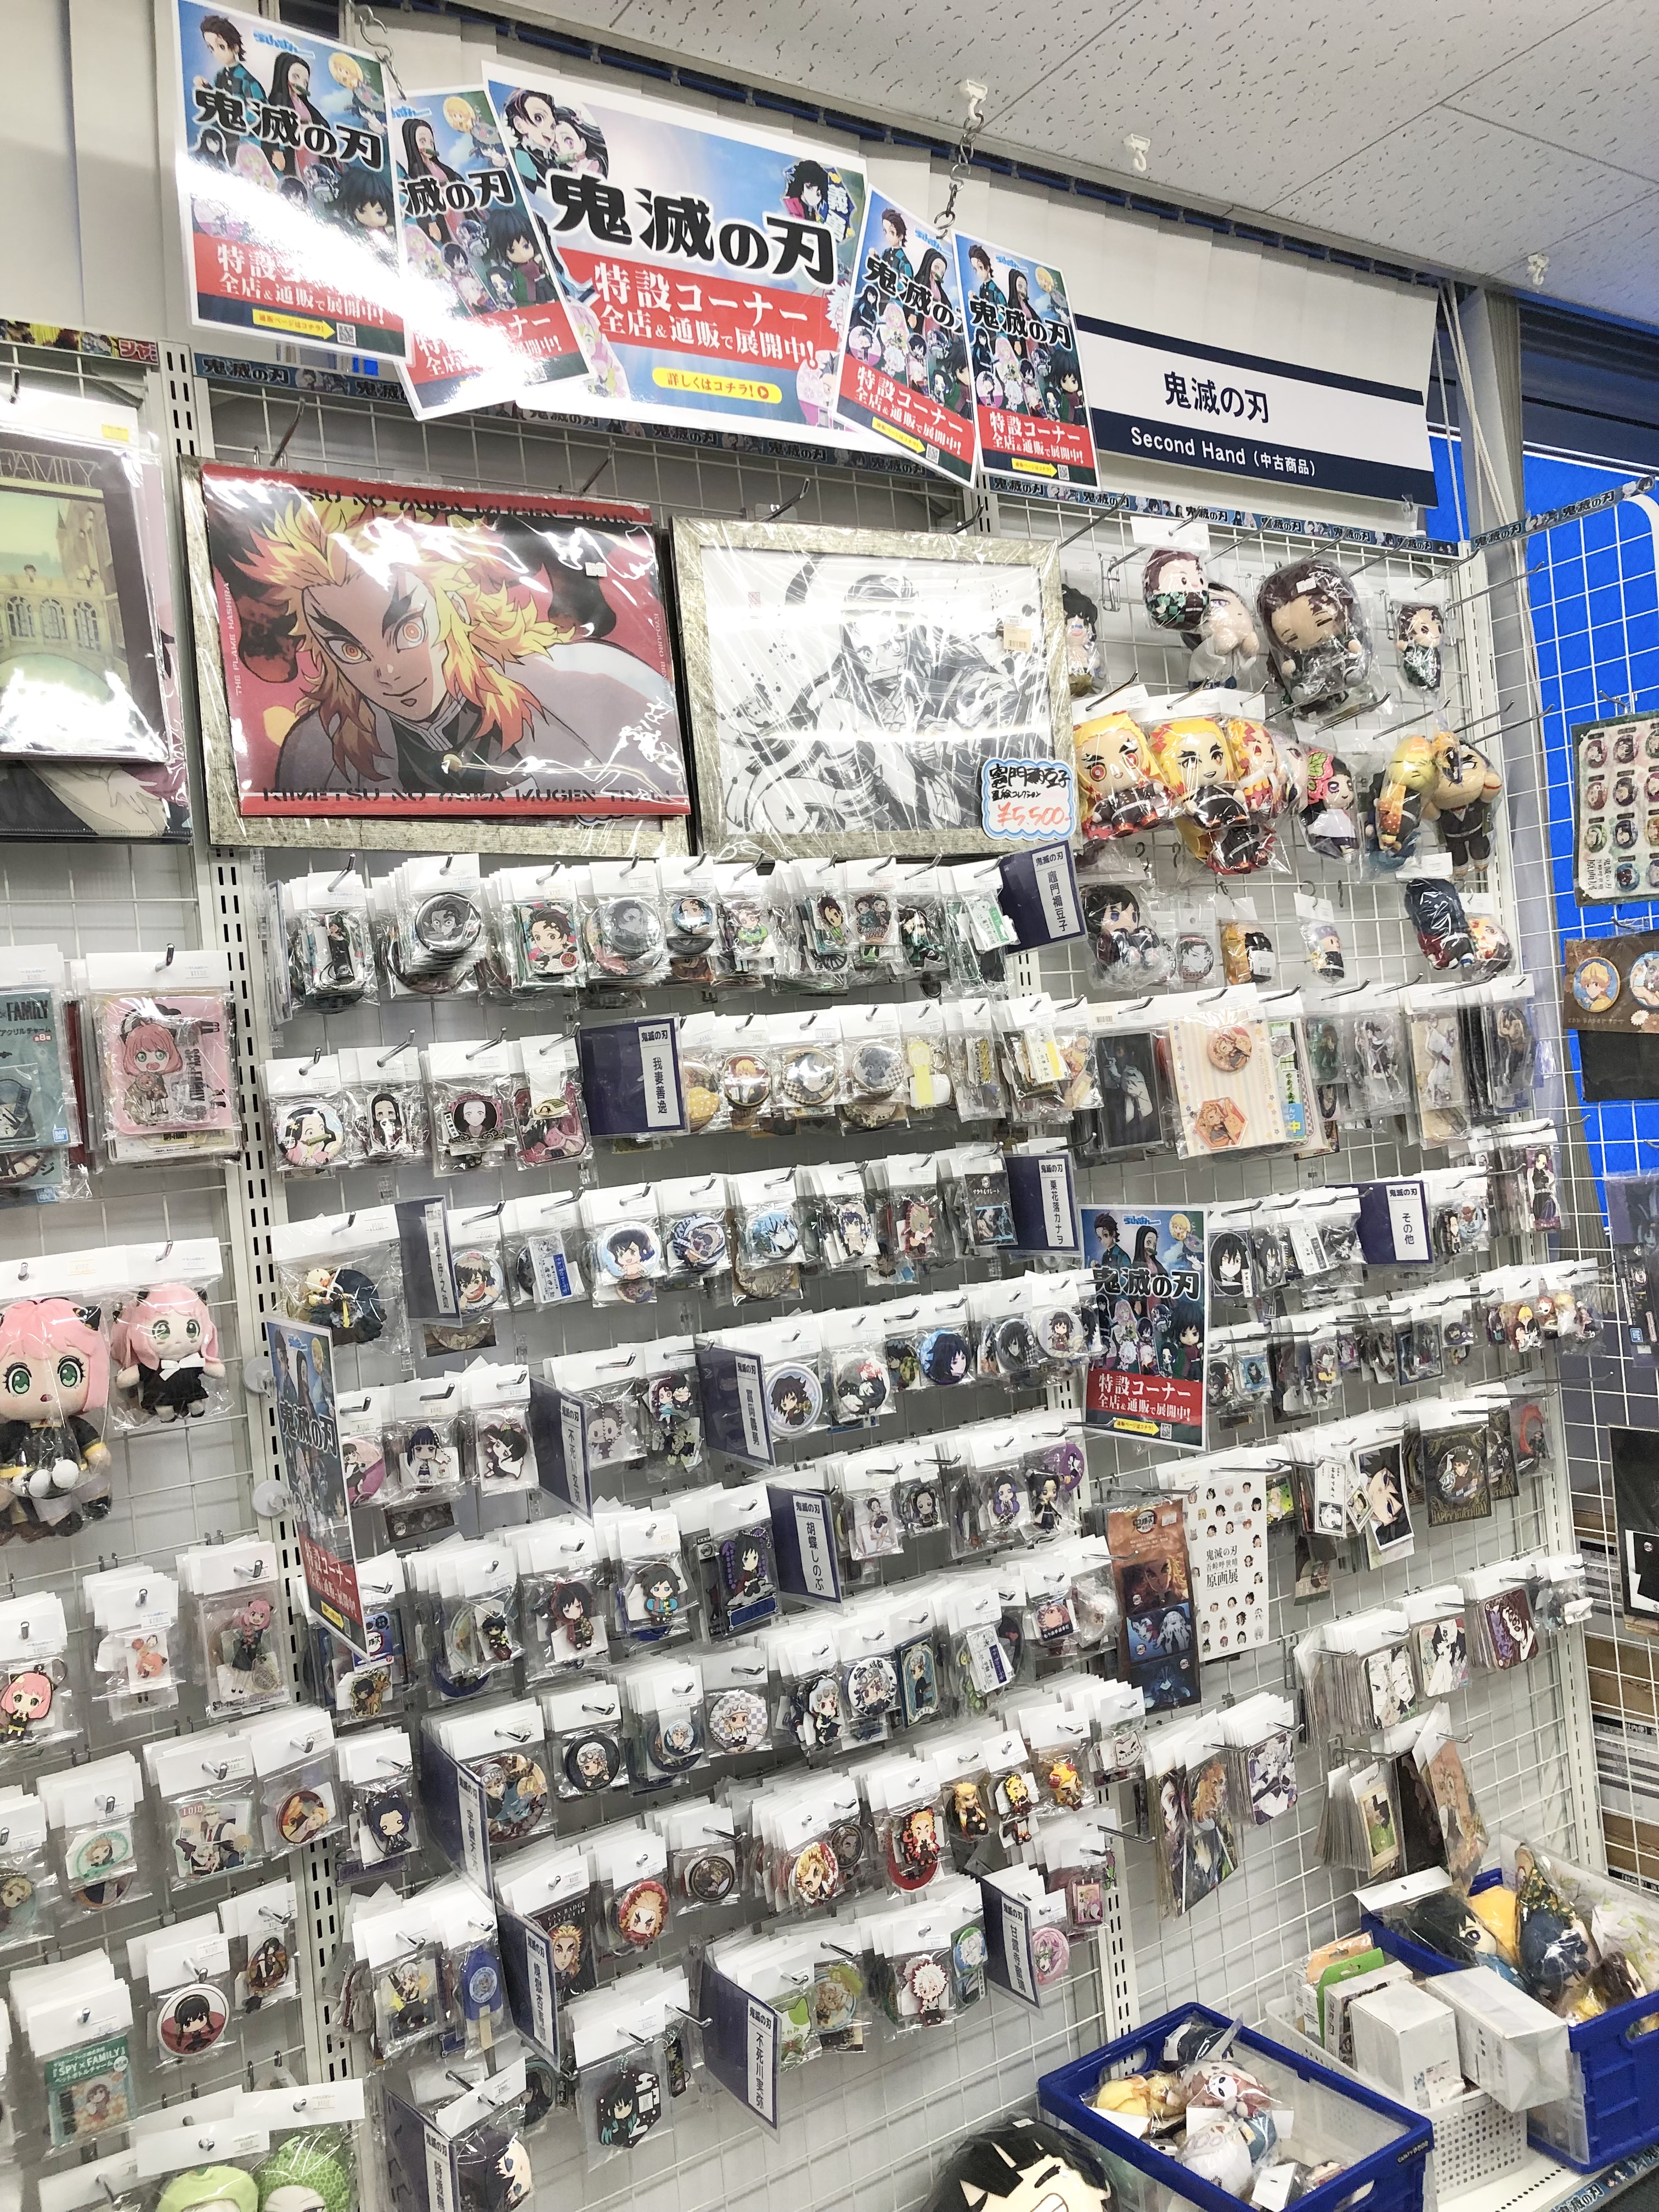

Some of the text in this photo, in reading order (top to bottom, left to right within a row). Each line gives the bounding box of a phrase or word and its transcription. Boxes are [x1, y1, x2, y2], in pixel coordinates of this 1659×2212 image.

[195, 90, 382, 170] 鬼滅の刃
[397, 170, 514, 214] 滅の刃
[551, 173, 835, 285] 鬼滅の刃
[595, 262, 808, 326] 特設コーナー
[867, 257, 963, 329] 鬼滅の
[970, 301, 1071, 349] 鬼滅の刃
[667, 373, 754, 397] 詳しくはコチラ!
[857, 366, 964, 433] 特設コーナー
[1164, 371, 1268, 423] 鬼滅の刃
[204, 358, 290, 383] 鬼滅の刃
[653, 425, 718, 447] 鬼滅の刃
[768, 441, 827, 461] 鬼滅の刃
[990, 412, 1080, 442] 特設コーナー
[1131, 427, 1195, 456] Second
[1203, 441, 1246, 465] Hand
[994, 477, 1044, 494] 鬼滅の刃
[1084, 493, 1130, 508] 鬼滅の刃
[1476, 490, 1615, 548] 鬼滅の刃 鬼滅の刃
[224, 583, 242, 696] THE FLAME HASHIRA
[1036, 851, 1063, 867] 鬼滅の刃
[641, 1030, 668, 1042] 鬼滅の刃
[653, 1057, 668, 1114] 我妻善逸
[1041, 1164, 1064, 1173] 鬼滅の刃
[1390, 1189, 1418, 1197] 鬼滅の刃
[1402, 1214, 1416, 1245] その他
[1094, 1266, 1200, 1300] 鬼滅の刃
[1099, 1373, 1192, 1401] 特設コーナー
[280, 1401, 338, 1458] 鬼滅の刃
[796, 1502, 821, 1514] 鬼滅の刃
[1431, 1500, 1488, 1525] HAPPY BIRTHDAY
[806, 1521, 825, 1591] 胡蝶しのぶ
[1207, 1545, 1238, 1561] 鬼滅の刃
[1207, 1568, 1239, 1588] 原画展
[184, 1805, 203, 1816] LOID
[565, 1901, 586, 1915] BADGE
[750, 2007, 771, 2030] 鬼滅の刃
[756, 2032, 764, 2110] 不死川実弥
